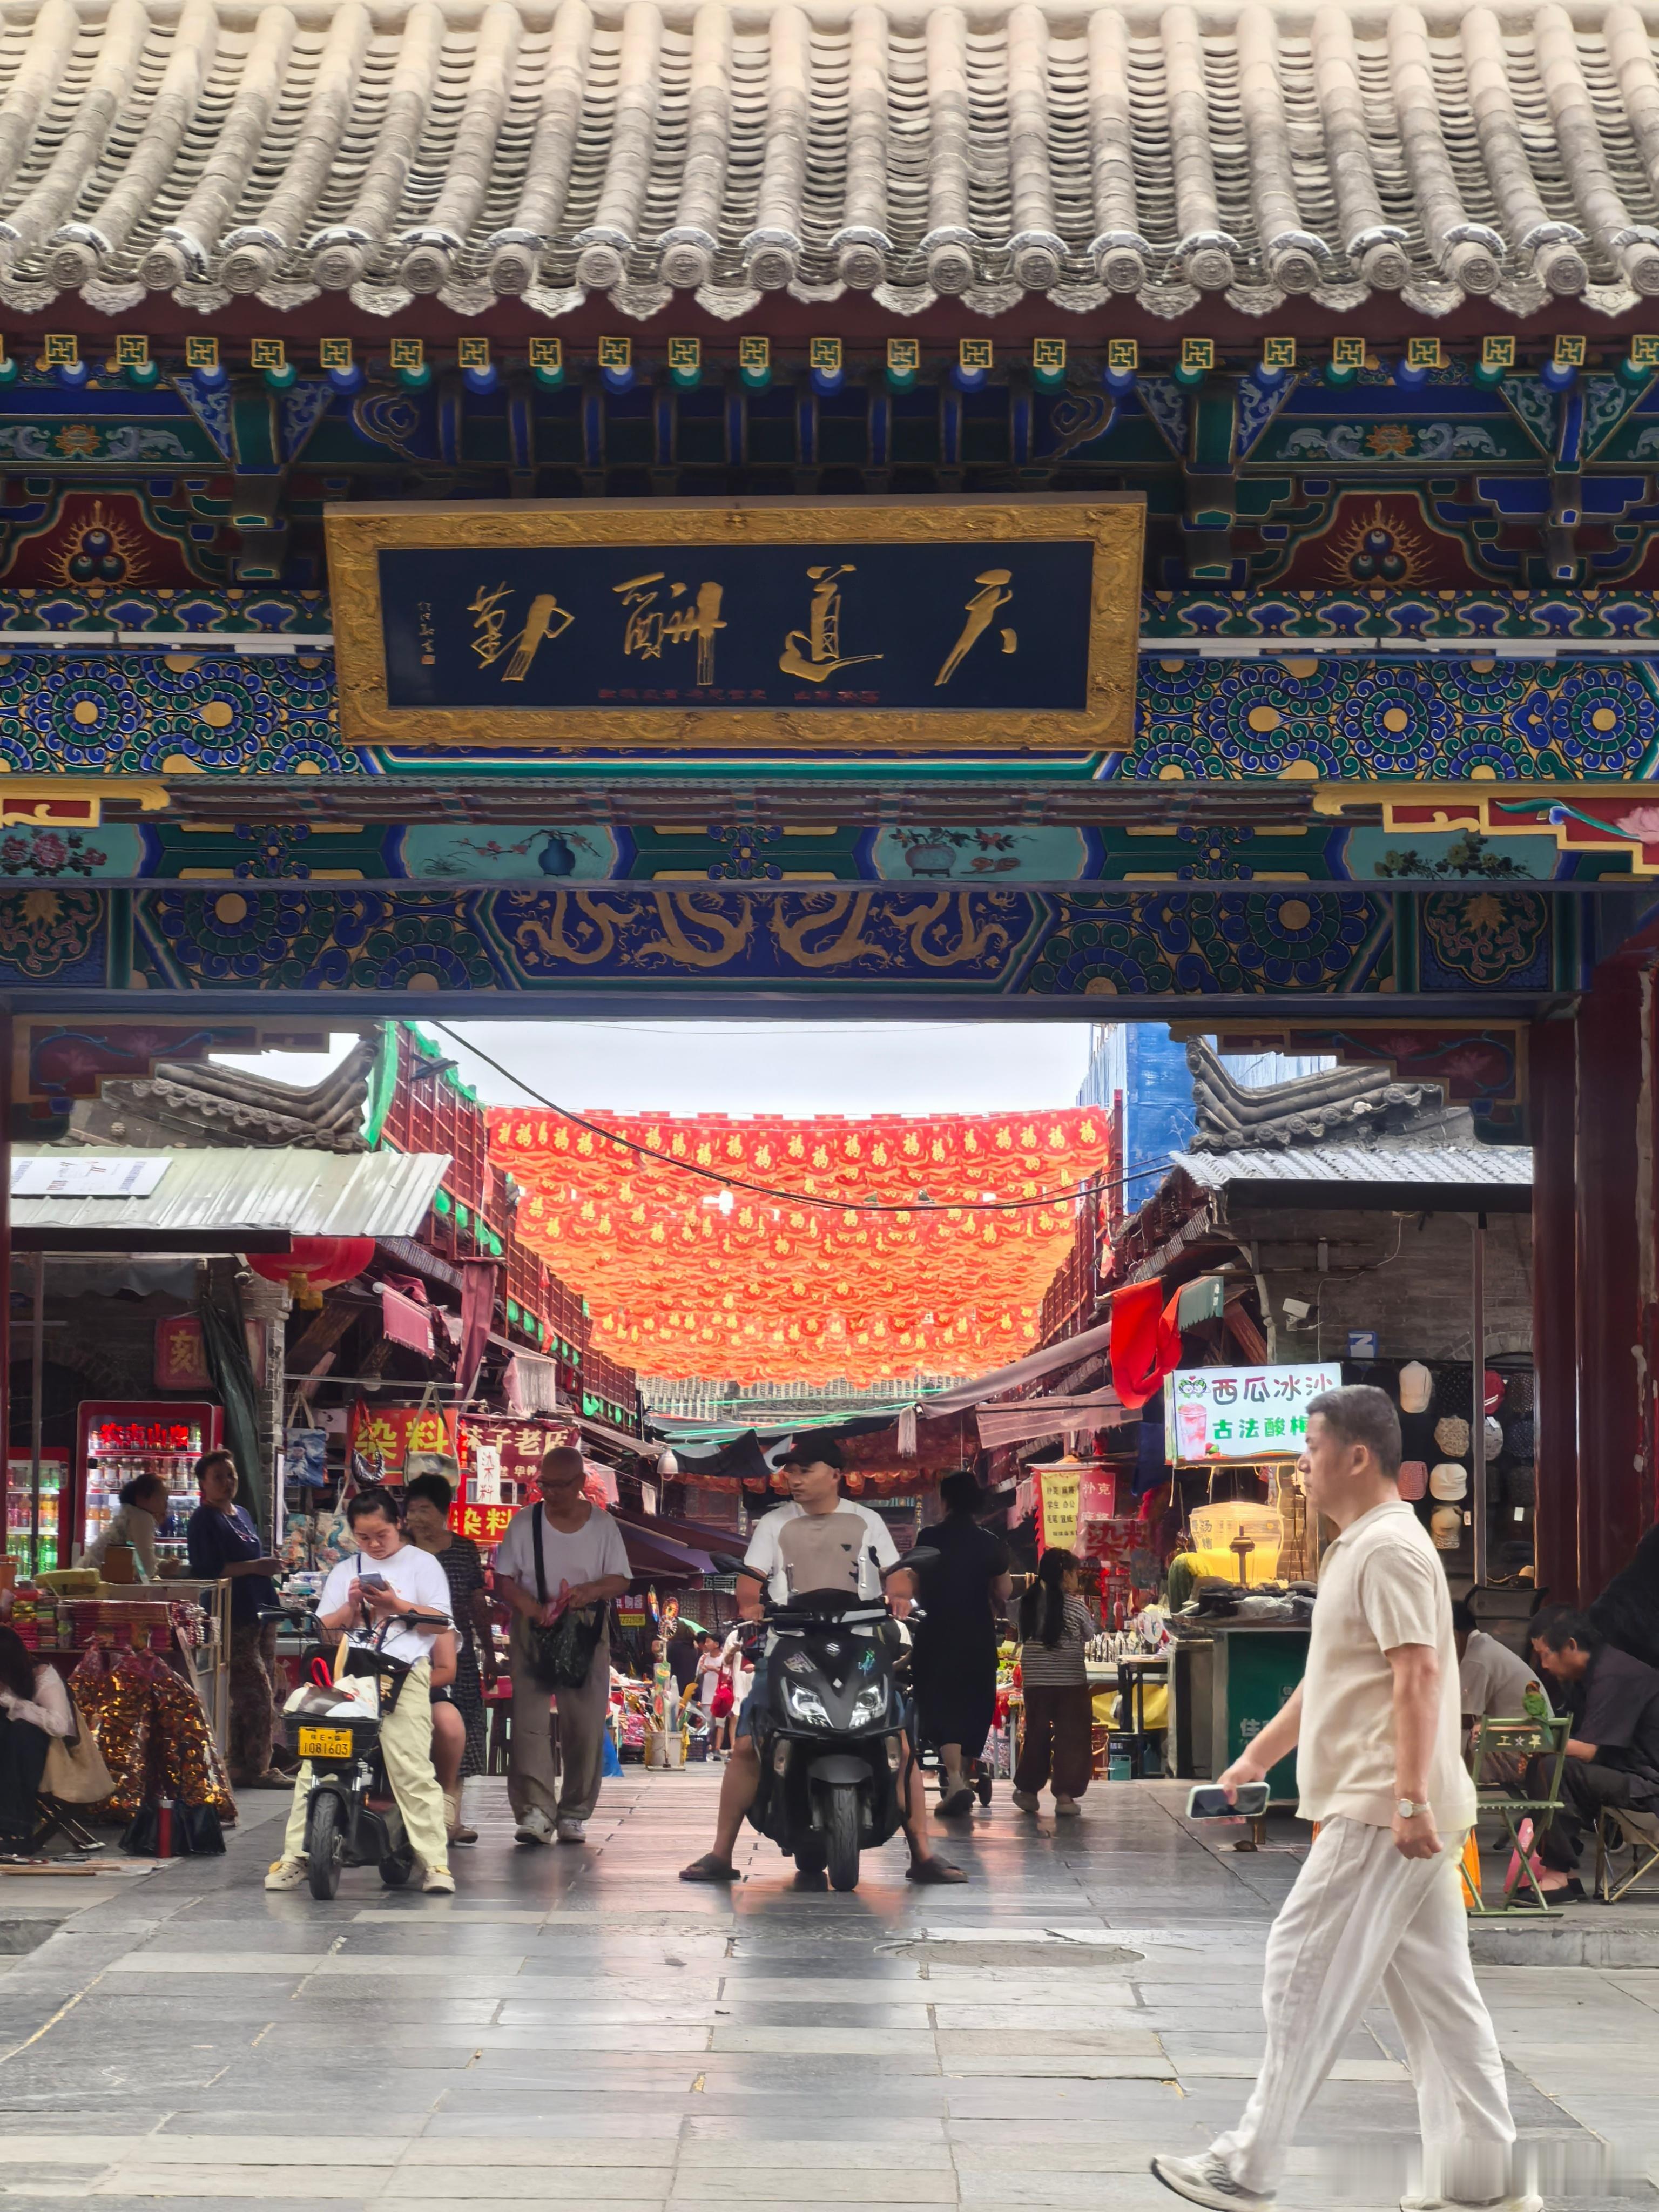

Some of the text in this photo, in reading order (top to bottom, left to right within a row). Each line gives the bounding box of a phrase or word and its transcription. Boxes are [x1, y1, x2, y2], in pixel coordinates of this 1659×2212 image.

[466, 564, 1019, 687] 天道酬勤
[516, 1124, 531, 1147] 福
[554, 1127, 569, 1150] 福
[646, 1126, 661, 1150] 福
[995, 1127, 1011, 1148] 福
[1020, 1125, 1036, 1148] 福
[1048, 1124, 1065, 1148] 福
[1079, 1118, 1096, 1143] 福
[577, 1131, 593, 1156] 福
[672, 1134, 686, 1157] 福
[696, 1142, 712, 1166] 福
[727, 1134, 742, 1158] 福
[788, 1134, 804, 1156] 福
[845, 1134, 860, 1158] 福
[872, 1142, 887, 1166] 福
[903, 1133, 919, 1155] 福
[755, 1145, 771, 1169] 福
[812, 1145, 828, 1169] 福
[1211, 1373, 1333, 1405] 西瓜冰沙
[354, 1417, 449, 1460] 染料
[1082, 1482, 1111, 1495] 扑克
[1047, 1500, 1060, 1509] 学生
[453, 1507, 512, 1536] 染料
